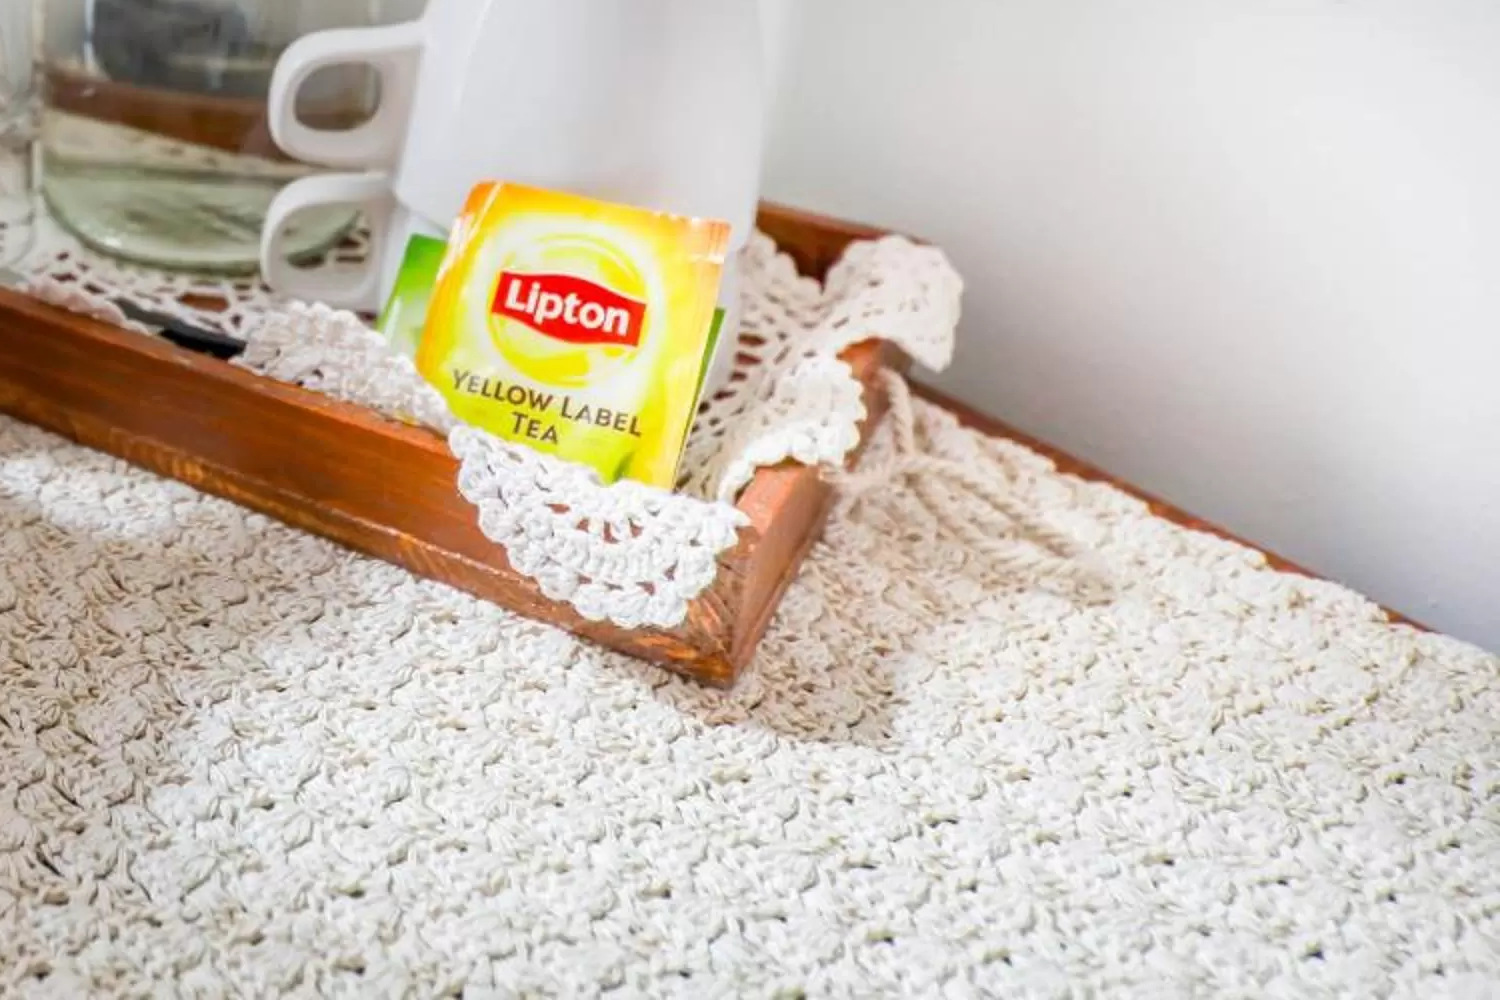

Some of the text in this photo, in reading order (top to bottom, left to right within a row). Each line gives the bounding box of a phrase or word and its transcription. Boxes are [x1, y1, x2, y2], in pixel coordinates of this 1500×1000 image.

[506, 279, 630, 336] Lipton
[452, 369, 642, 438] YELLOW LABEL
[511, 411, 558, 445] TEA
